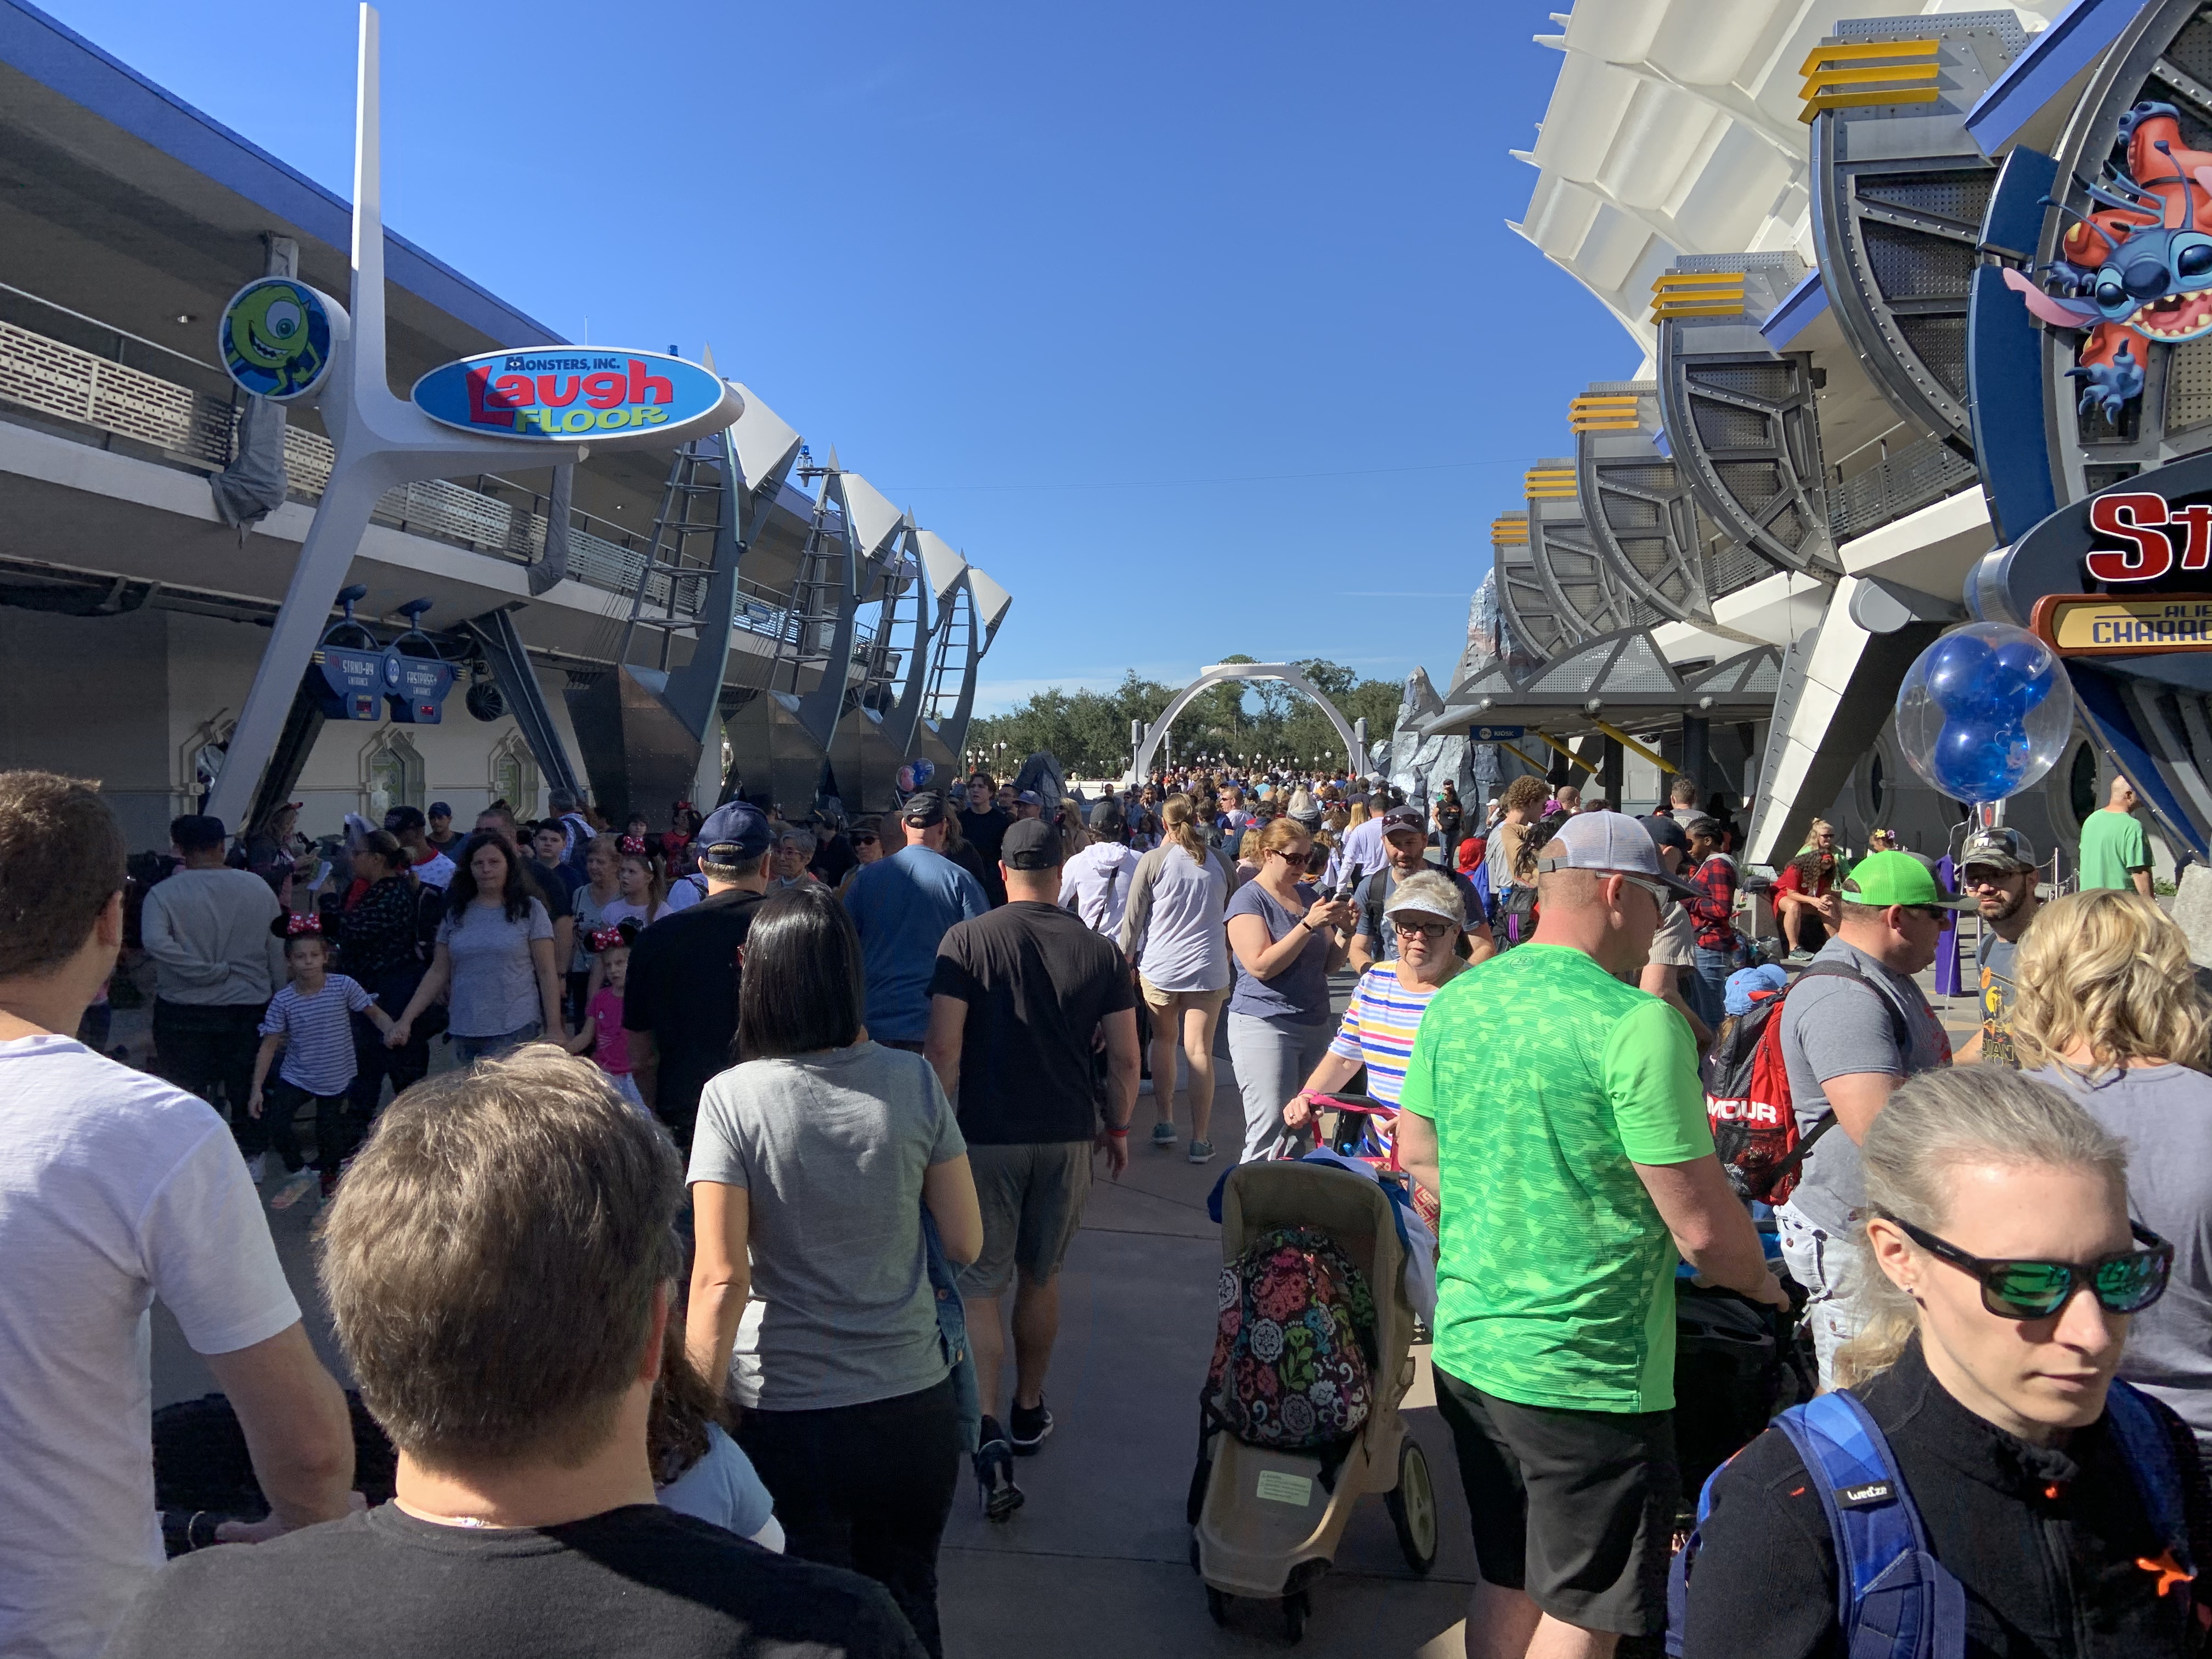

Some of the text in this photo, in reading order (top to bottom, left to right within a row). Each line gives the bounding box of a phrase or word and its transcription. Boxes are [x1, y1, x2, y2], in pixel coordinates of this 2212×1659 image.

[504, 356, 620, 371] MONSTERS, INC.
[465, 359, 673, 427] Laugh
[516, 409, 668, 433] FLOOR
[2165, 605, 2212, 618] ALIE
[2093, 619, 2212, 643] CHARAC
[342, 659, 374, 675] STAND-BY
